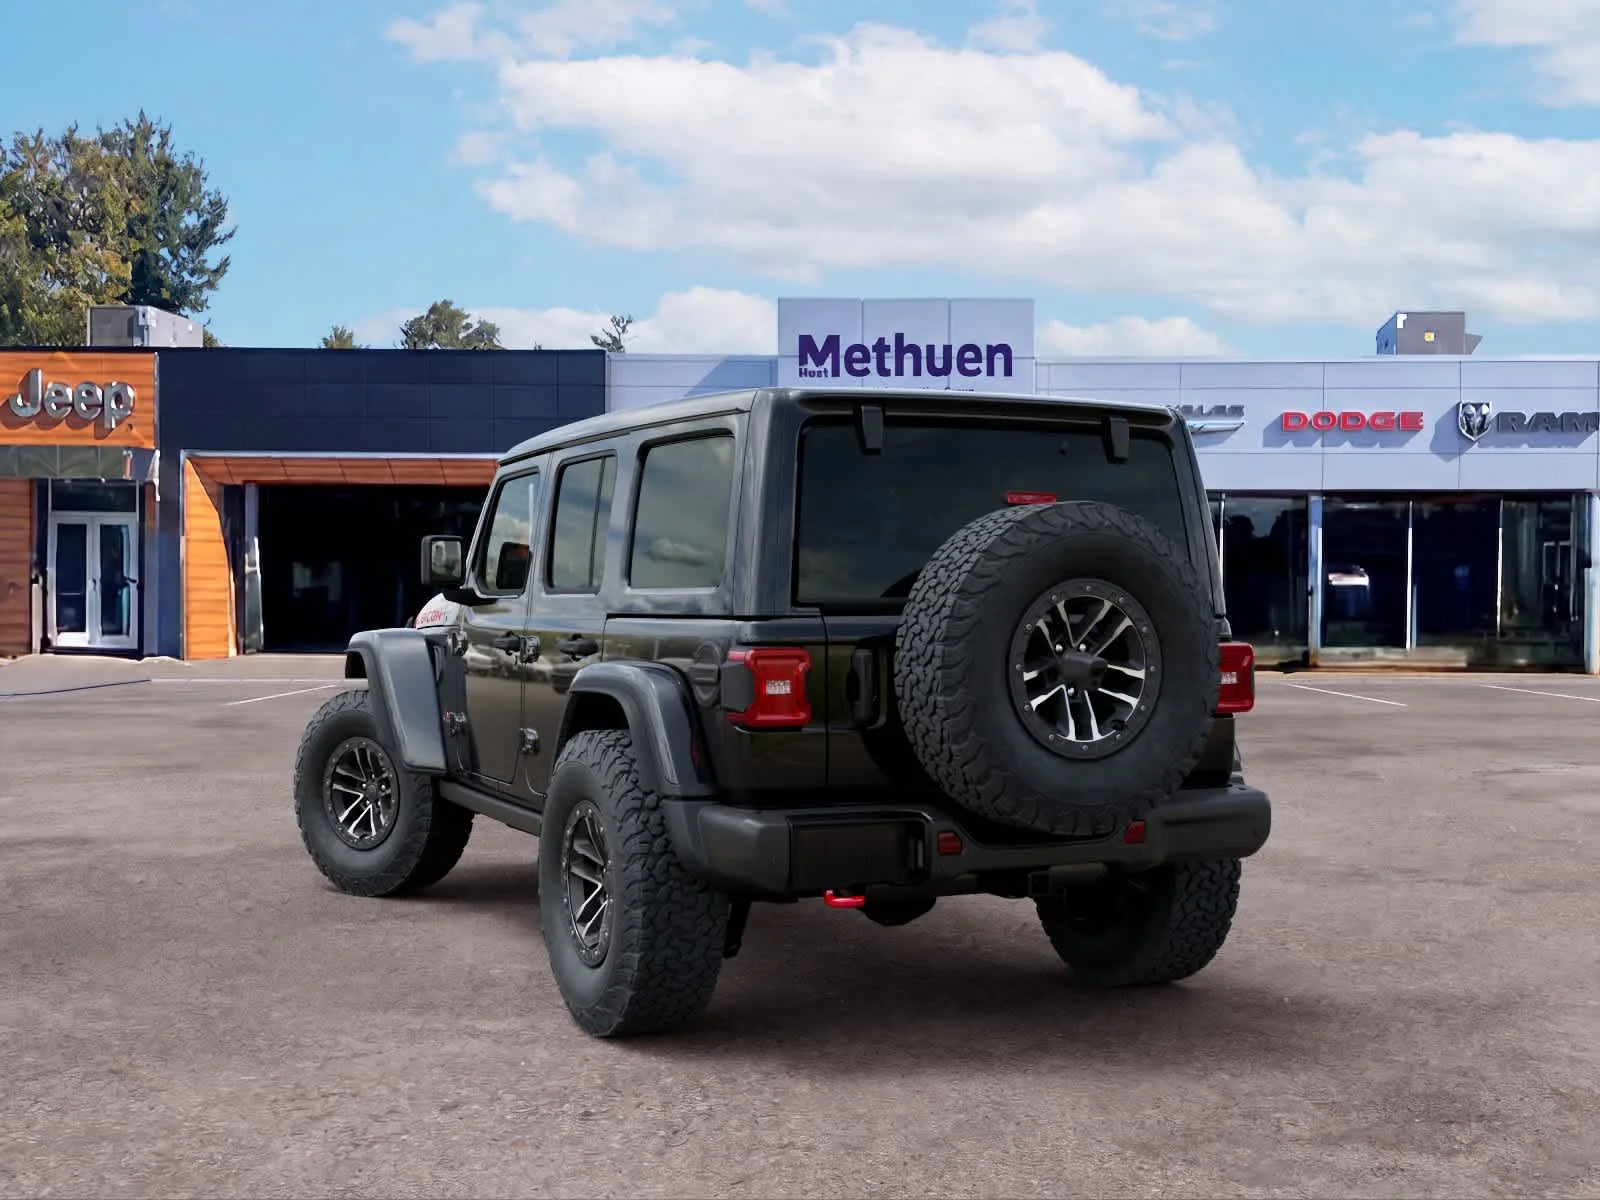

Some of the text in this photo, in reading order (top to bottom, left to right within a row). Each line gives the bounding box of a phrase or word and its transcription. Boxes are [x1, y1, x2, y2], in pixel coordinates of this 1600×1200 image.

[798, 332, 1012, 377] Methuen
[9, 368, 136, 429] Jeep
[1281, 411, 1423, 432] DODGE
[1497, 411, 1600, 433] RAM
